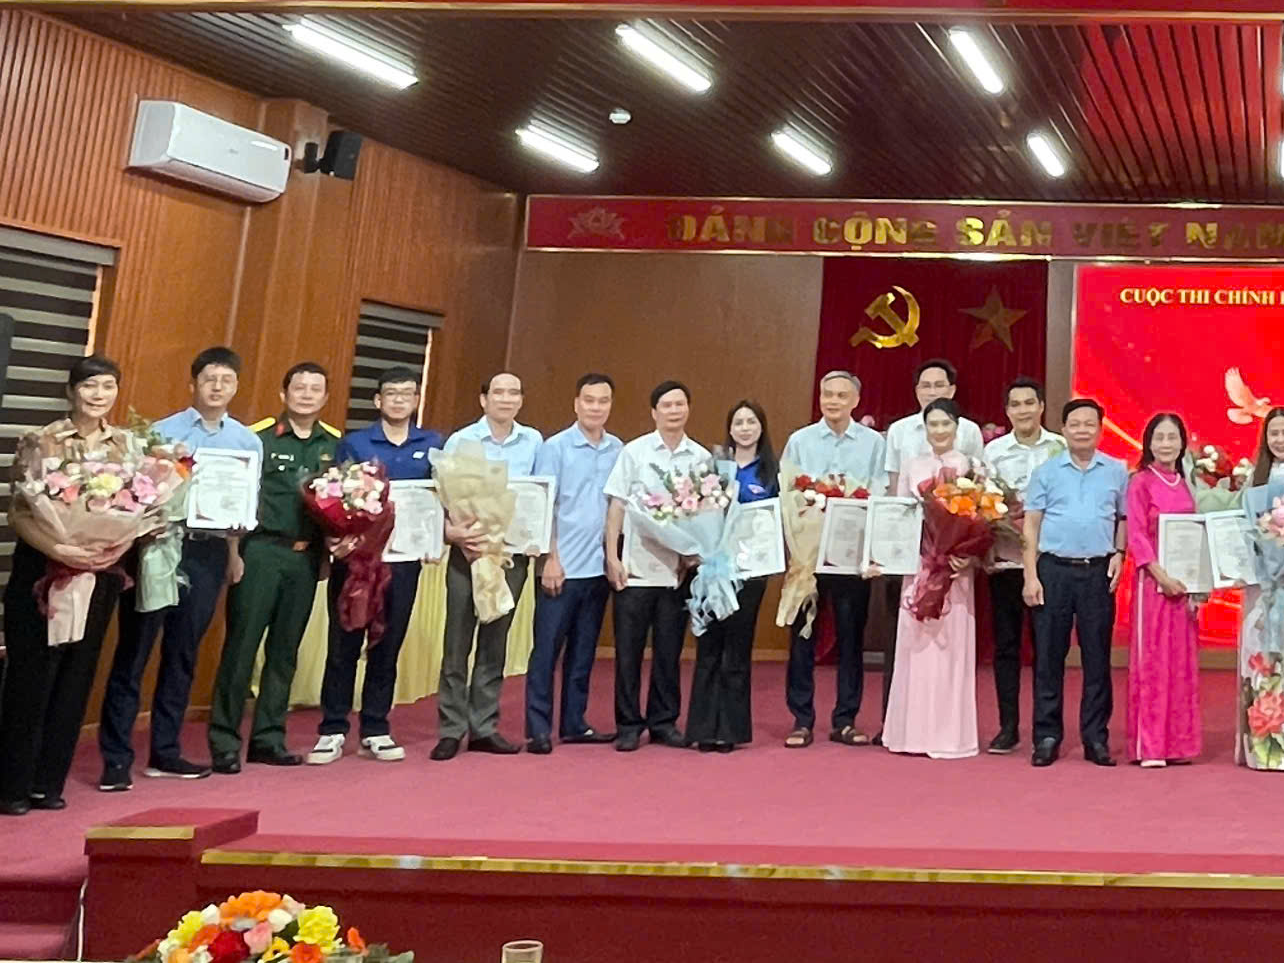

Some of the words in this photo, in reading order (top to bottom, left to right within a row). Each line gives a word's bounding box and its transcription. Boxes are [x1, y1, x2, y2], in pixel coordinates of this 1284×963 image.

[813, 211, 937, 250] CỘNG
[1120, 287, 1174, 307] CUỘC
[1177, 289, 1210, 305] THI
[1214, 287, 1276, 305] CHÍNH
